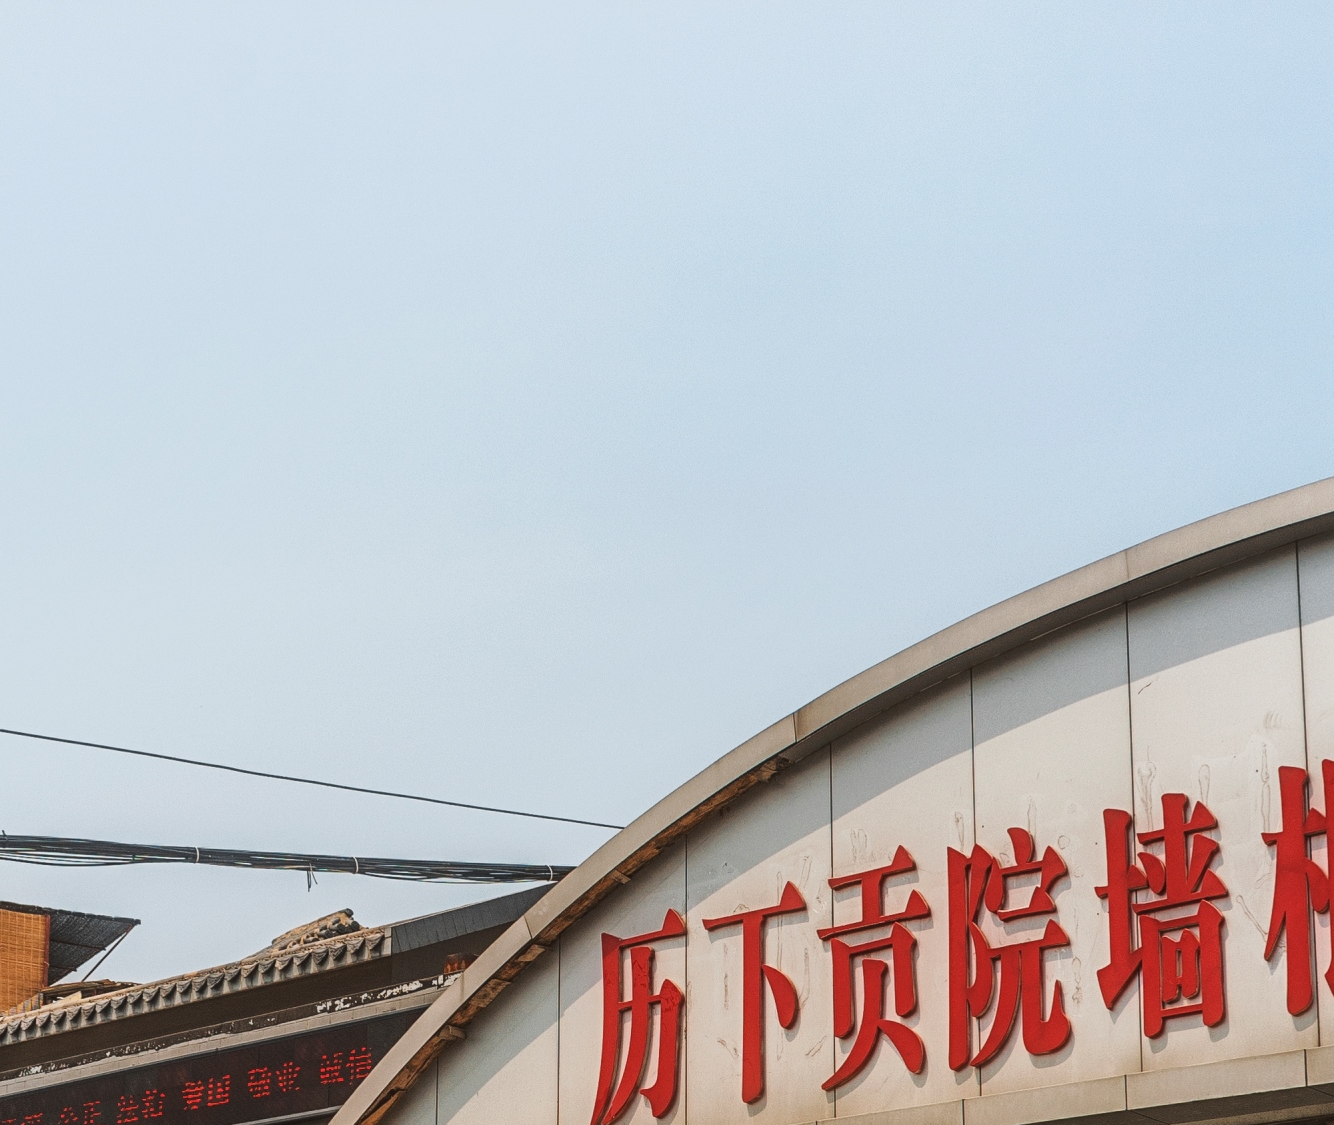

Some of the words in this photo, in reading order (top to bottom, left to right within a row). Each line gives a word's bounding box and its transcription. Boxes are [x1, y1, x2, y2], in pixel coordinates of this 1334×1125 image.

[117, 1090, 166, 1124] 法治
[182, 1074, 230, 1110] 爱国
[248, 1062, 301, 1097] 敬业
